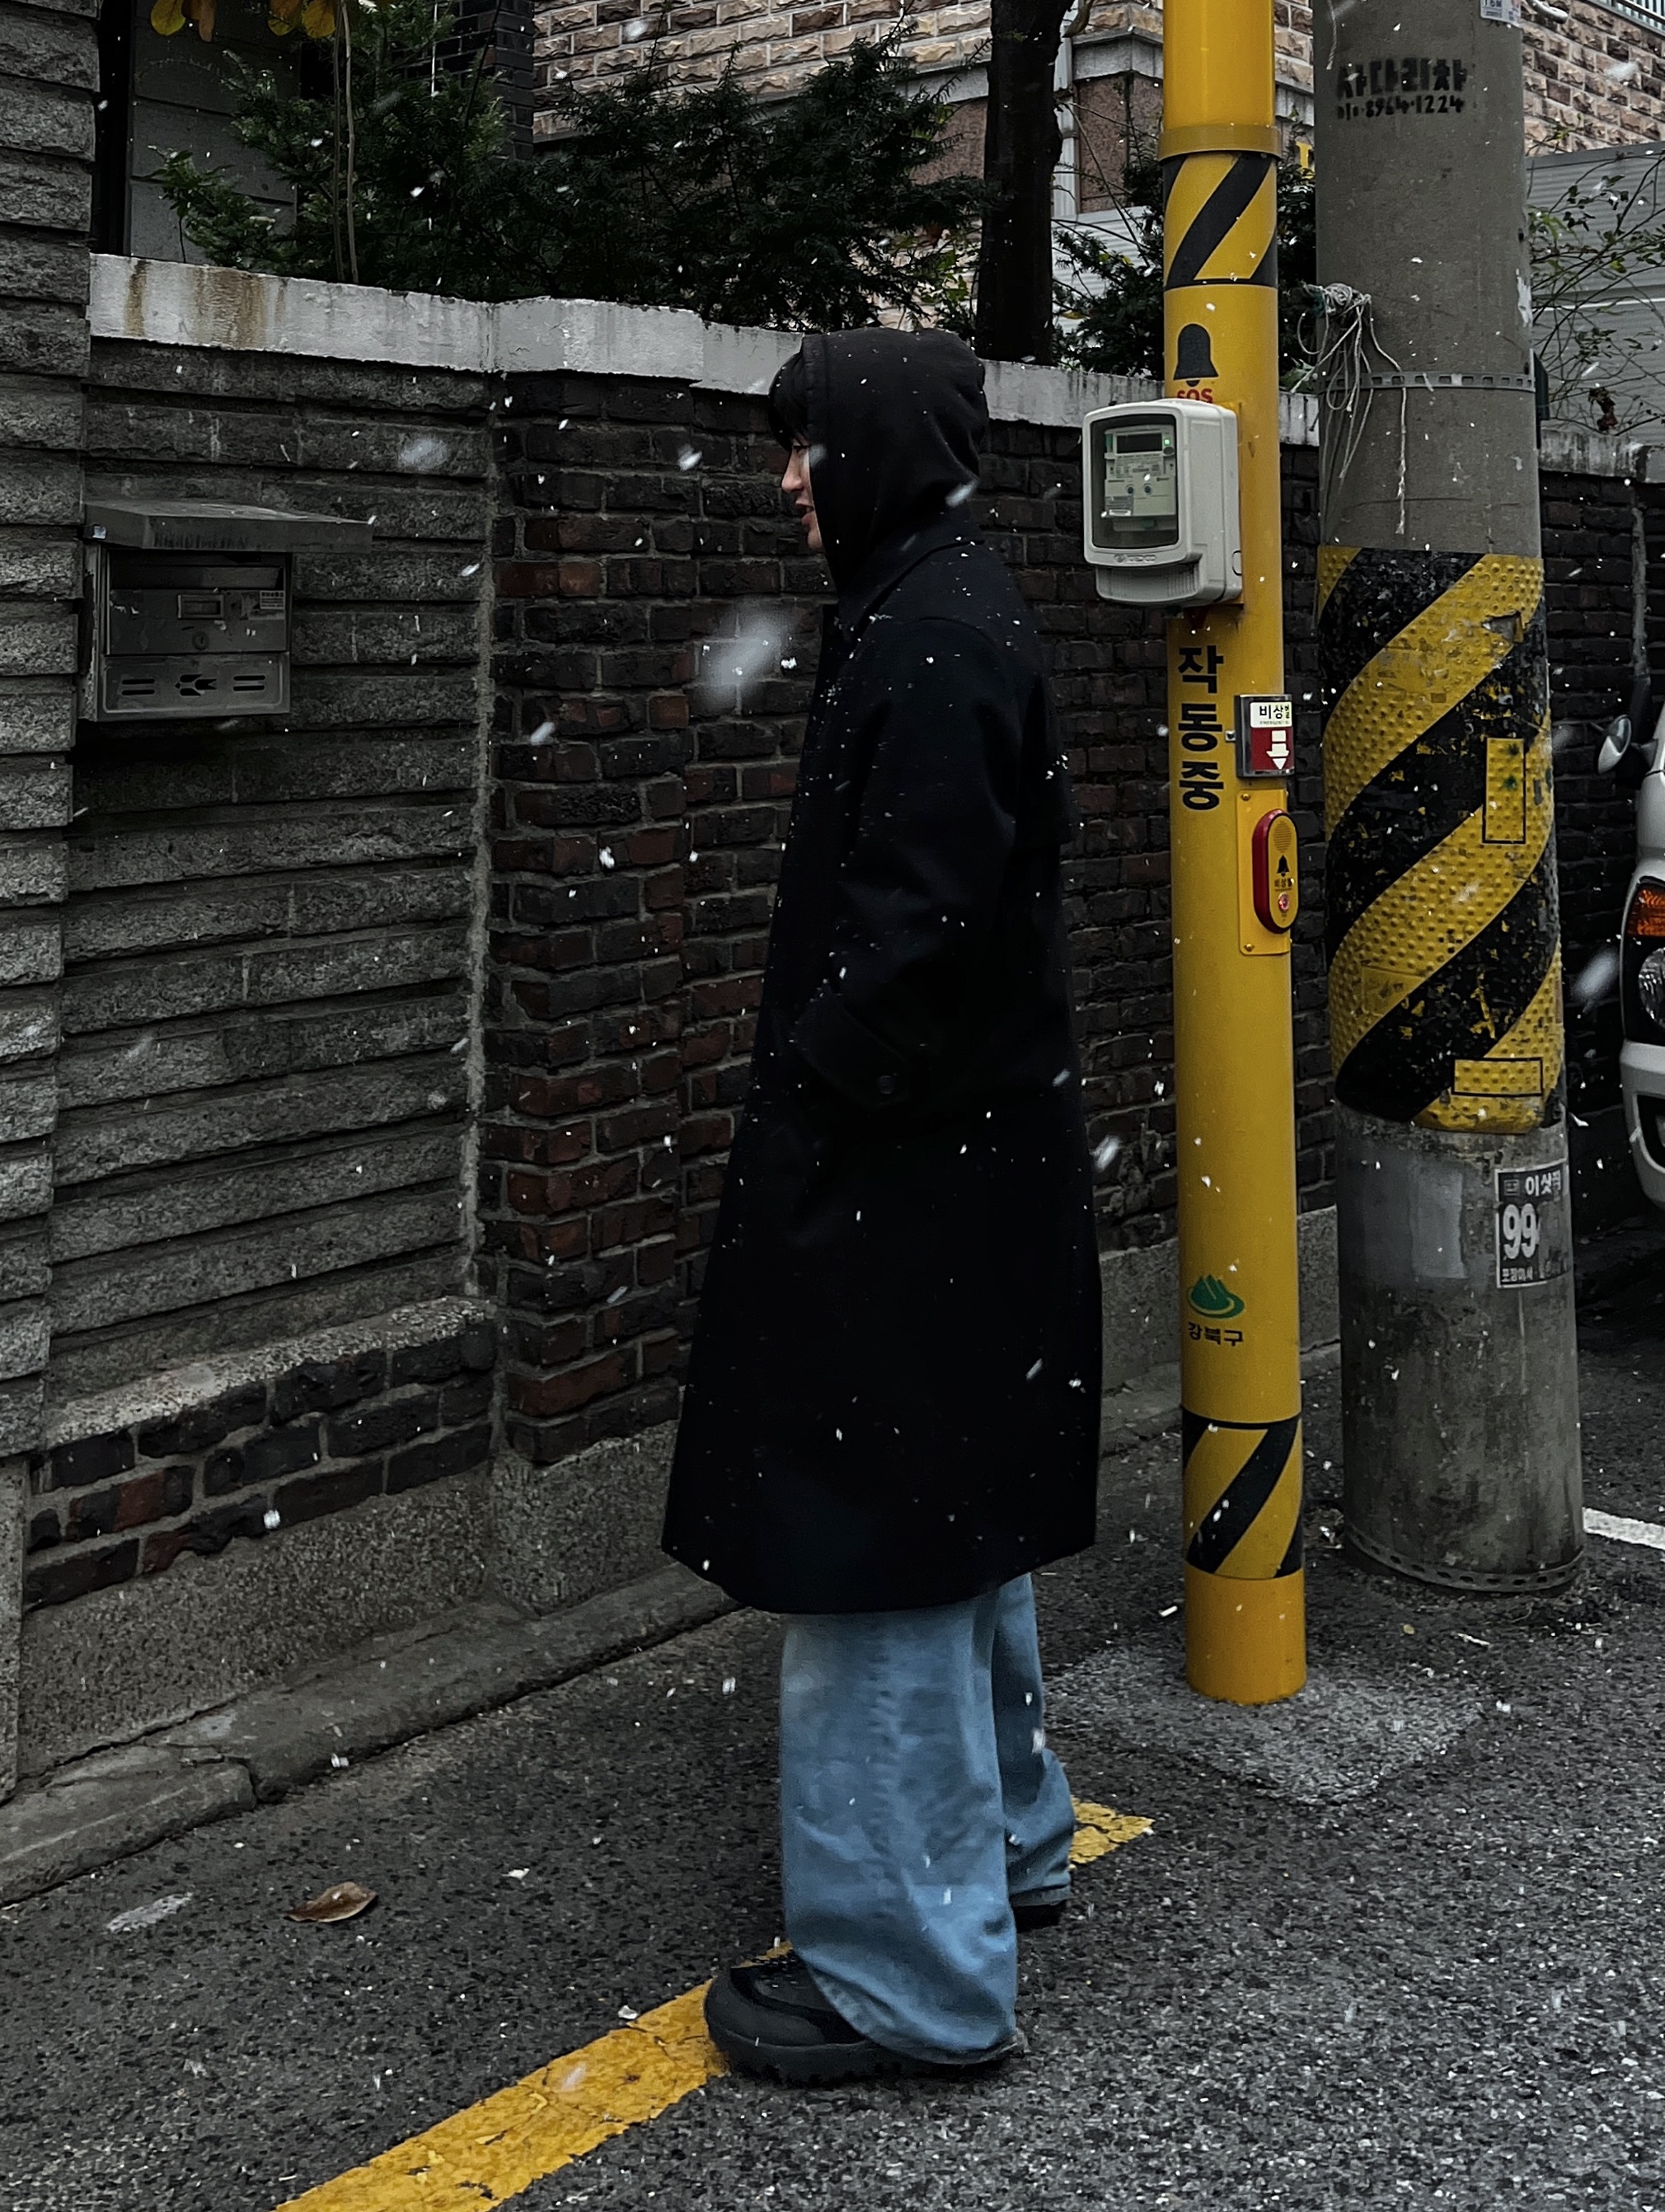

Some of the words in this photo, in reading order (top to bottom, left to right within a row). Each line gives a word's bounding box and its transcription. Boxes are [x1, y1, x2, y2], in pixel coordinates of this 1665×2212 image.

[1338, 59, 1466, 97] 사다리차
[1177, 644, 1224, 810] 작동중
[1188, 1322, 1244, 1347] 강북구
